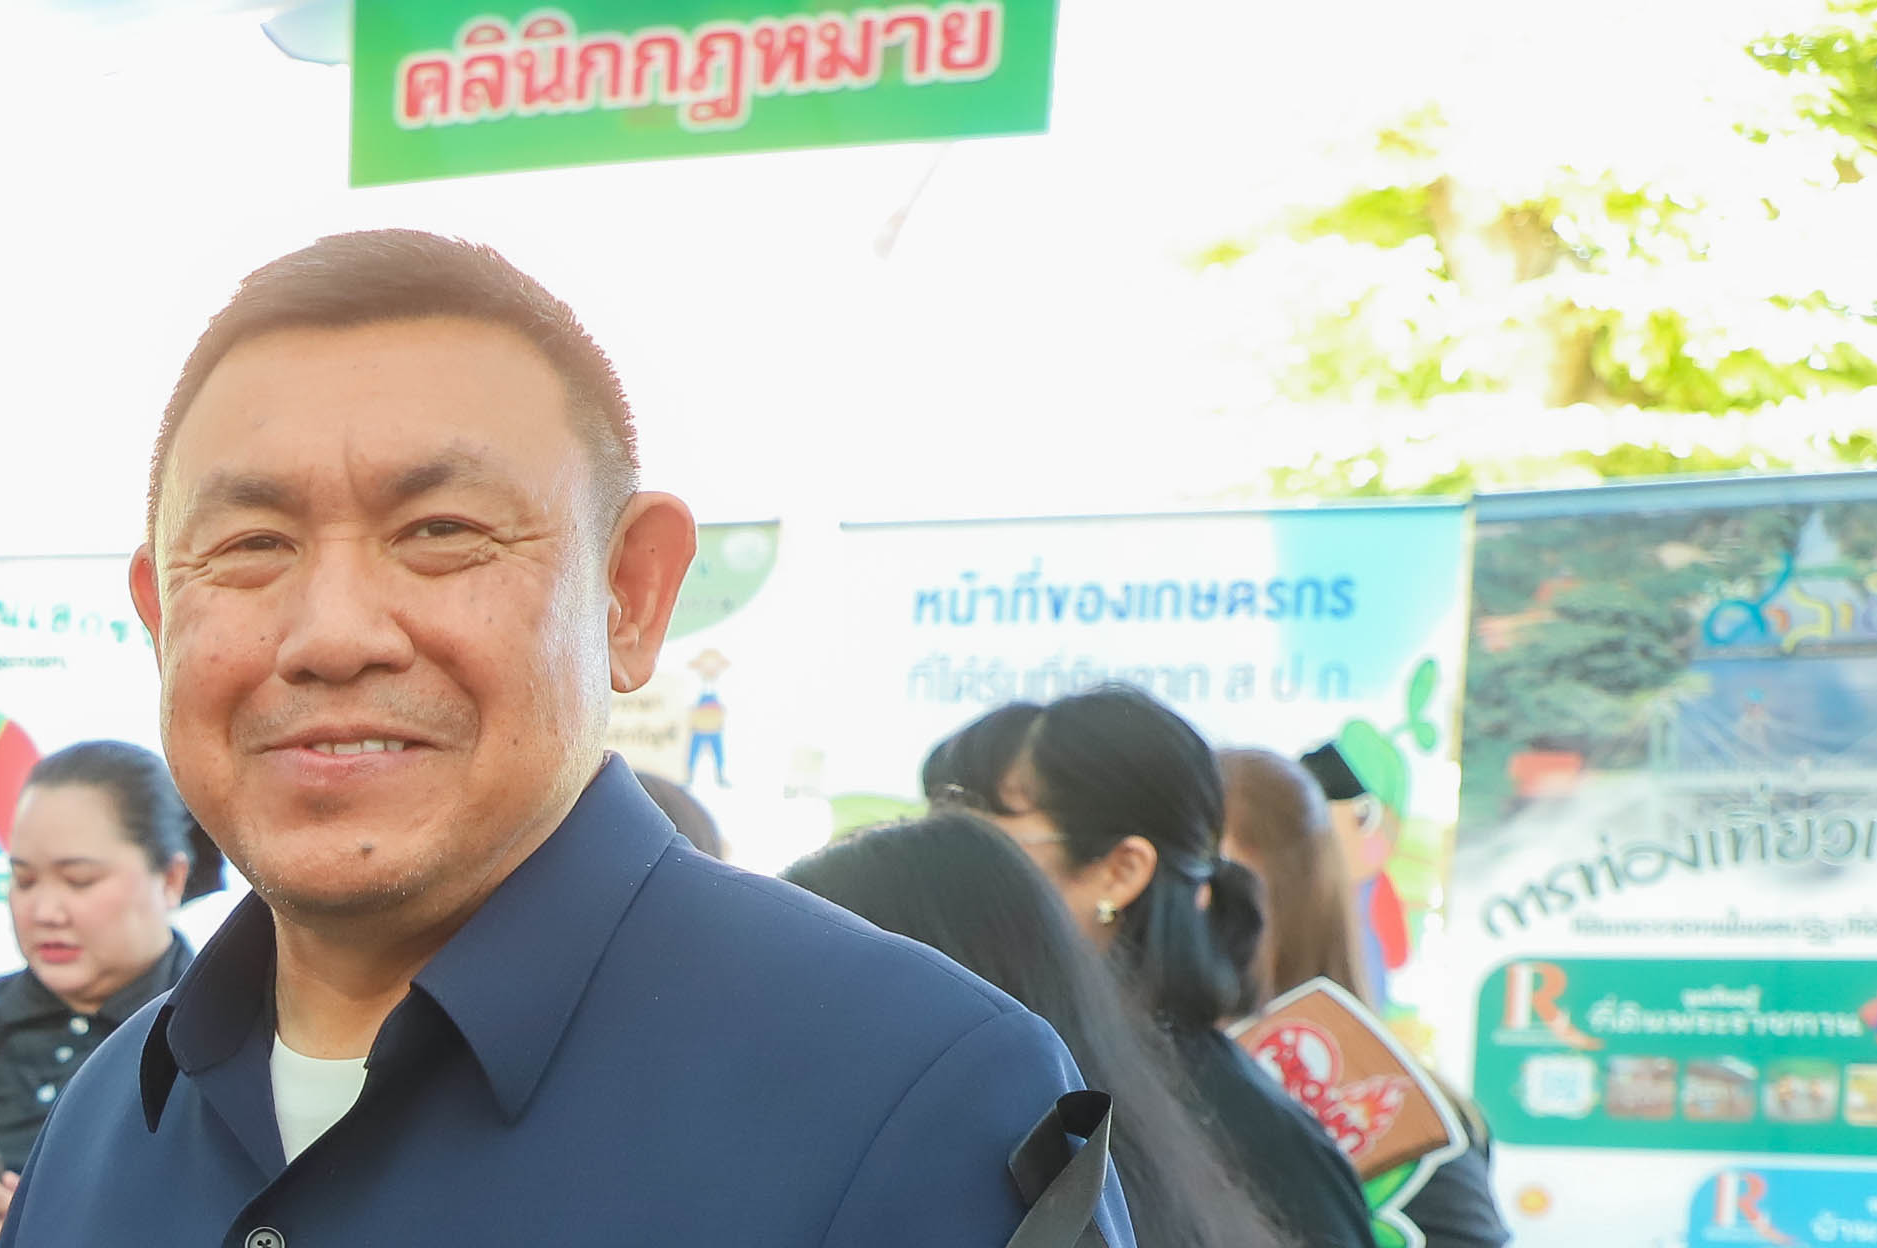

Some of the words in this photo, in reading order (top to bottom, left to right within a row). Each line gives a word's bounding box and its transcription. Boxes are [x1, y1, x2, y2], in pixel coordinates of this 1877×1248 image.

[400, 4, 998, 124] คลินิกกฎหมาย
[911, 555, 1358, 625] หน้าที่ของเกษตรกร
